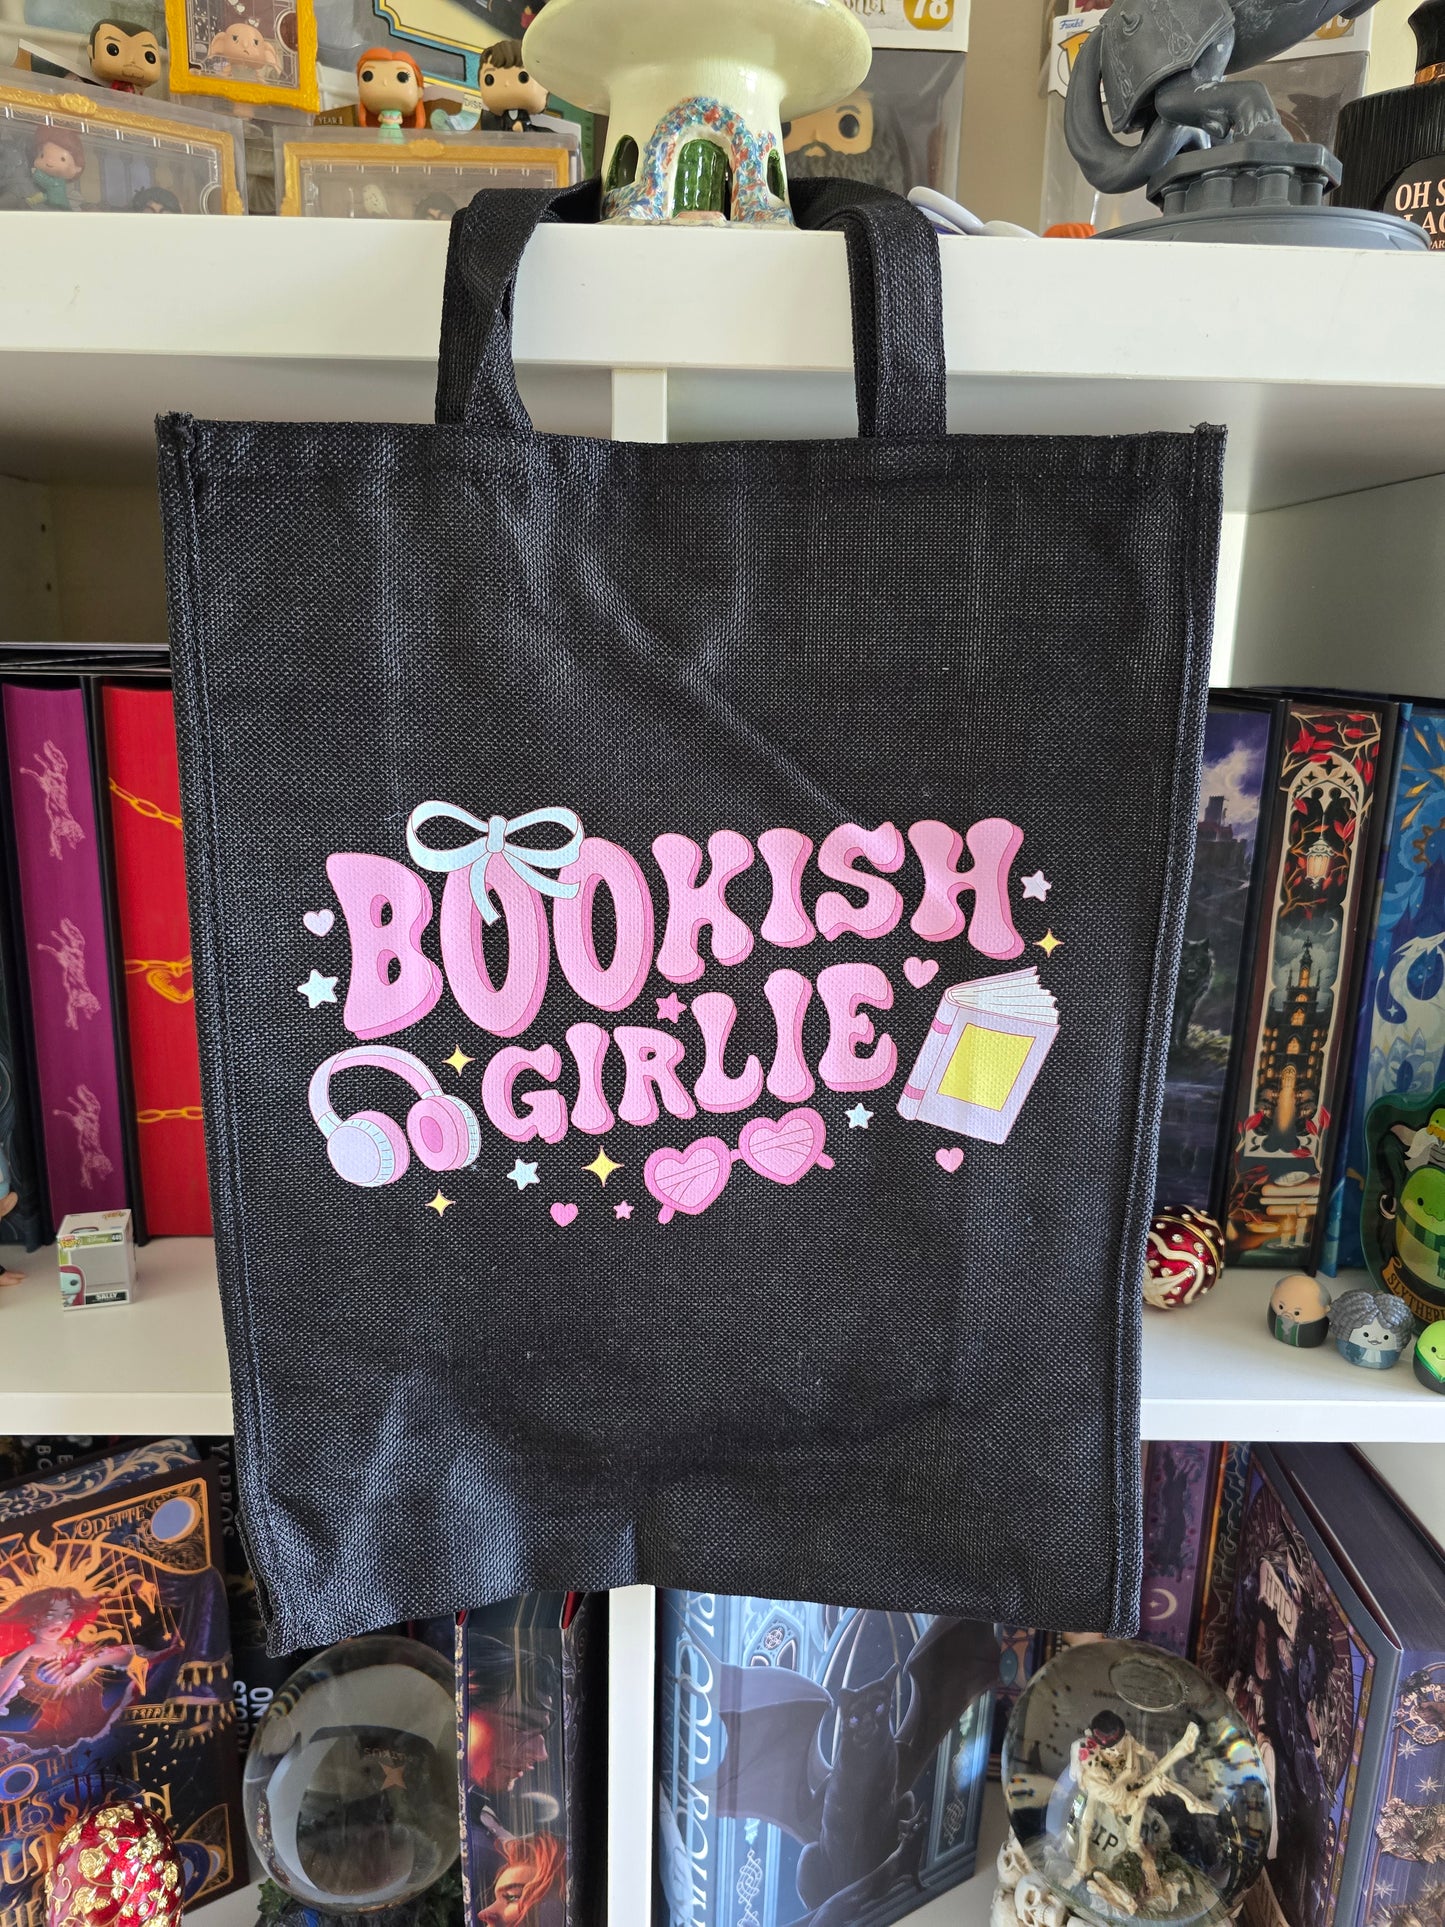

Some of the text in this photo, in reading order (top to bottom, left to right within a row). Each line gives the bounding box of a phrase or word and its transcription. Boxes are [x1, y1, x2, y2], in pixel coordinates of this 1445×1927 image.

[1395, 180, 1432, 211] OH
[325, 816, 1026, 1040] BOOKISH
[482, 962, 898, 1145] GIRLIE
[75, 1504, 147, 1538] ODETTE
